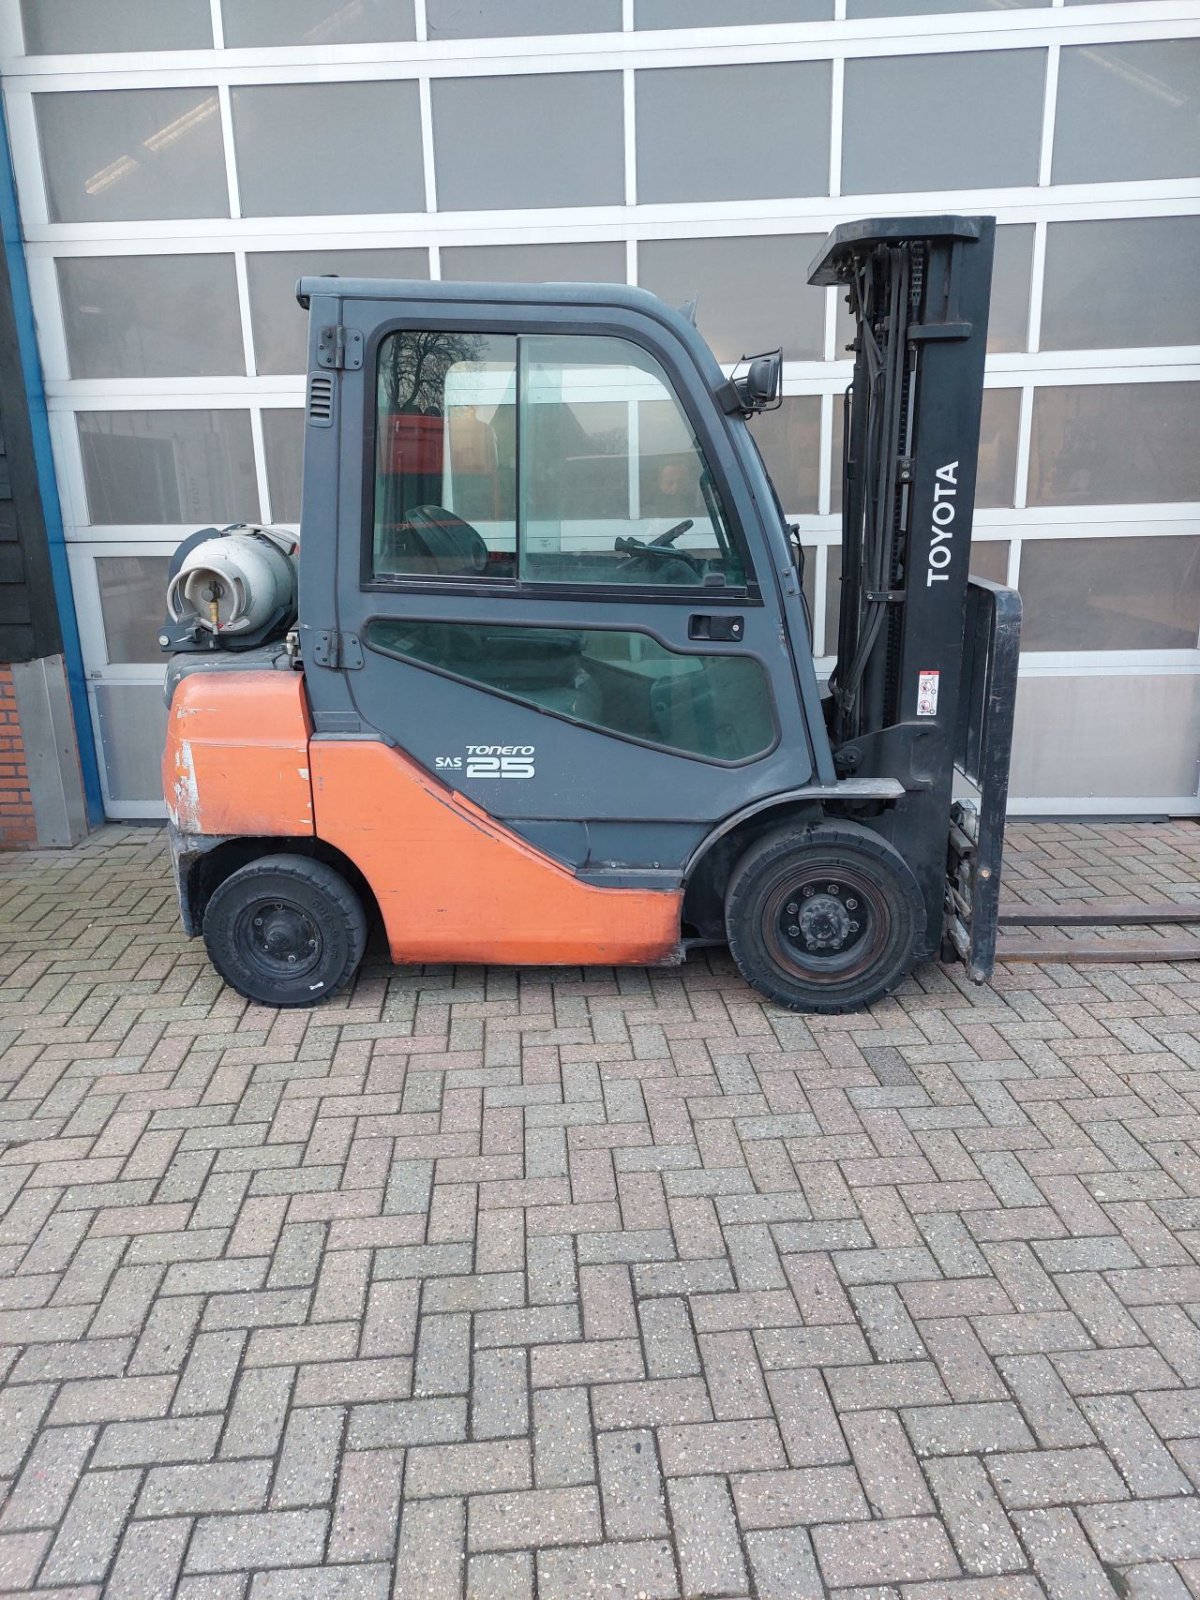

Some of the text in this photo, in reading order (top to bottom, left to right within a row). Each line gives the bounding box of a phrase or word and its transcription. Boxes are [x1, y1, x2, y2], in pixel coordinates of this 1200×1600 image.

[926, 460, 959, 588] TOYOTA
[465, 745, 535, 755] TONERO
[435, 756, 463, 768] SAS
[466, 757, 535, 779] 25
